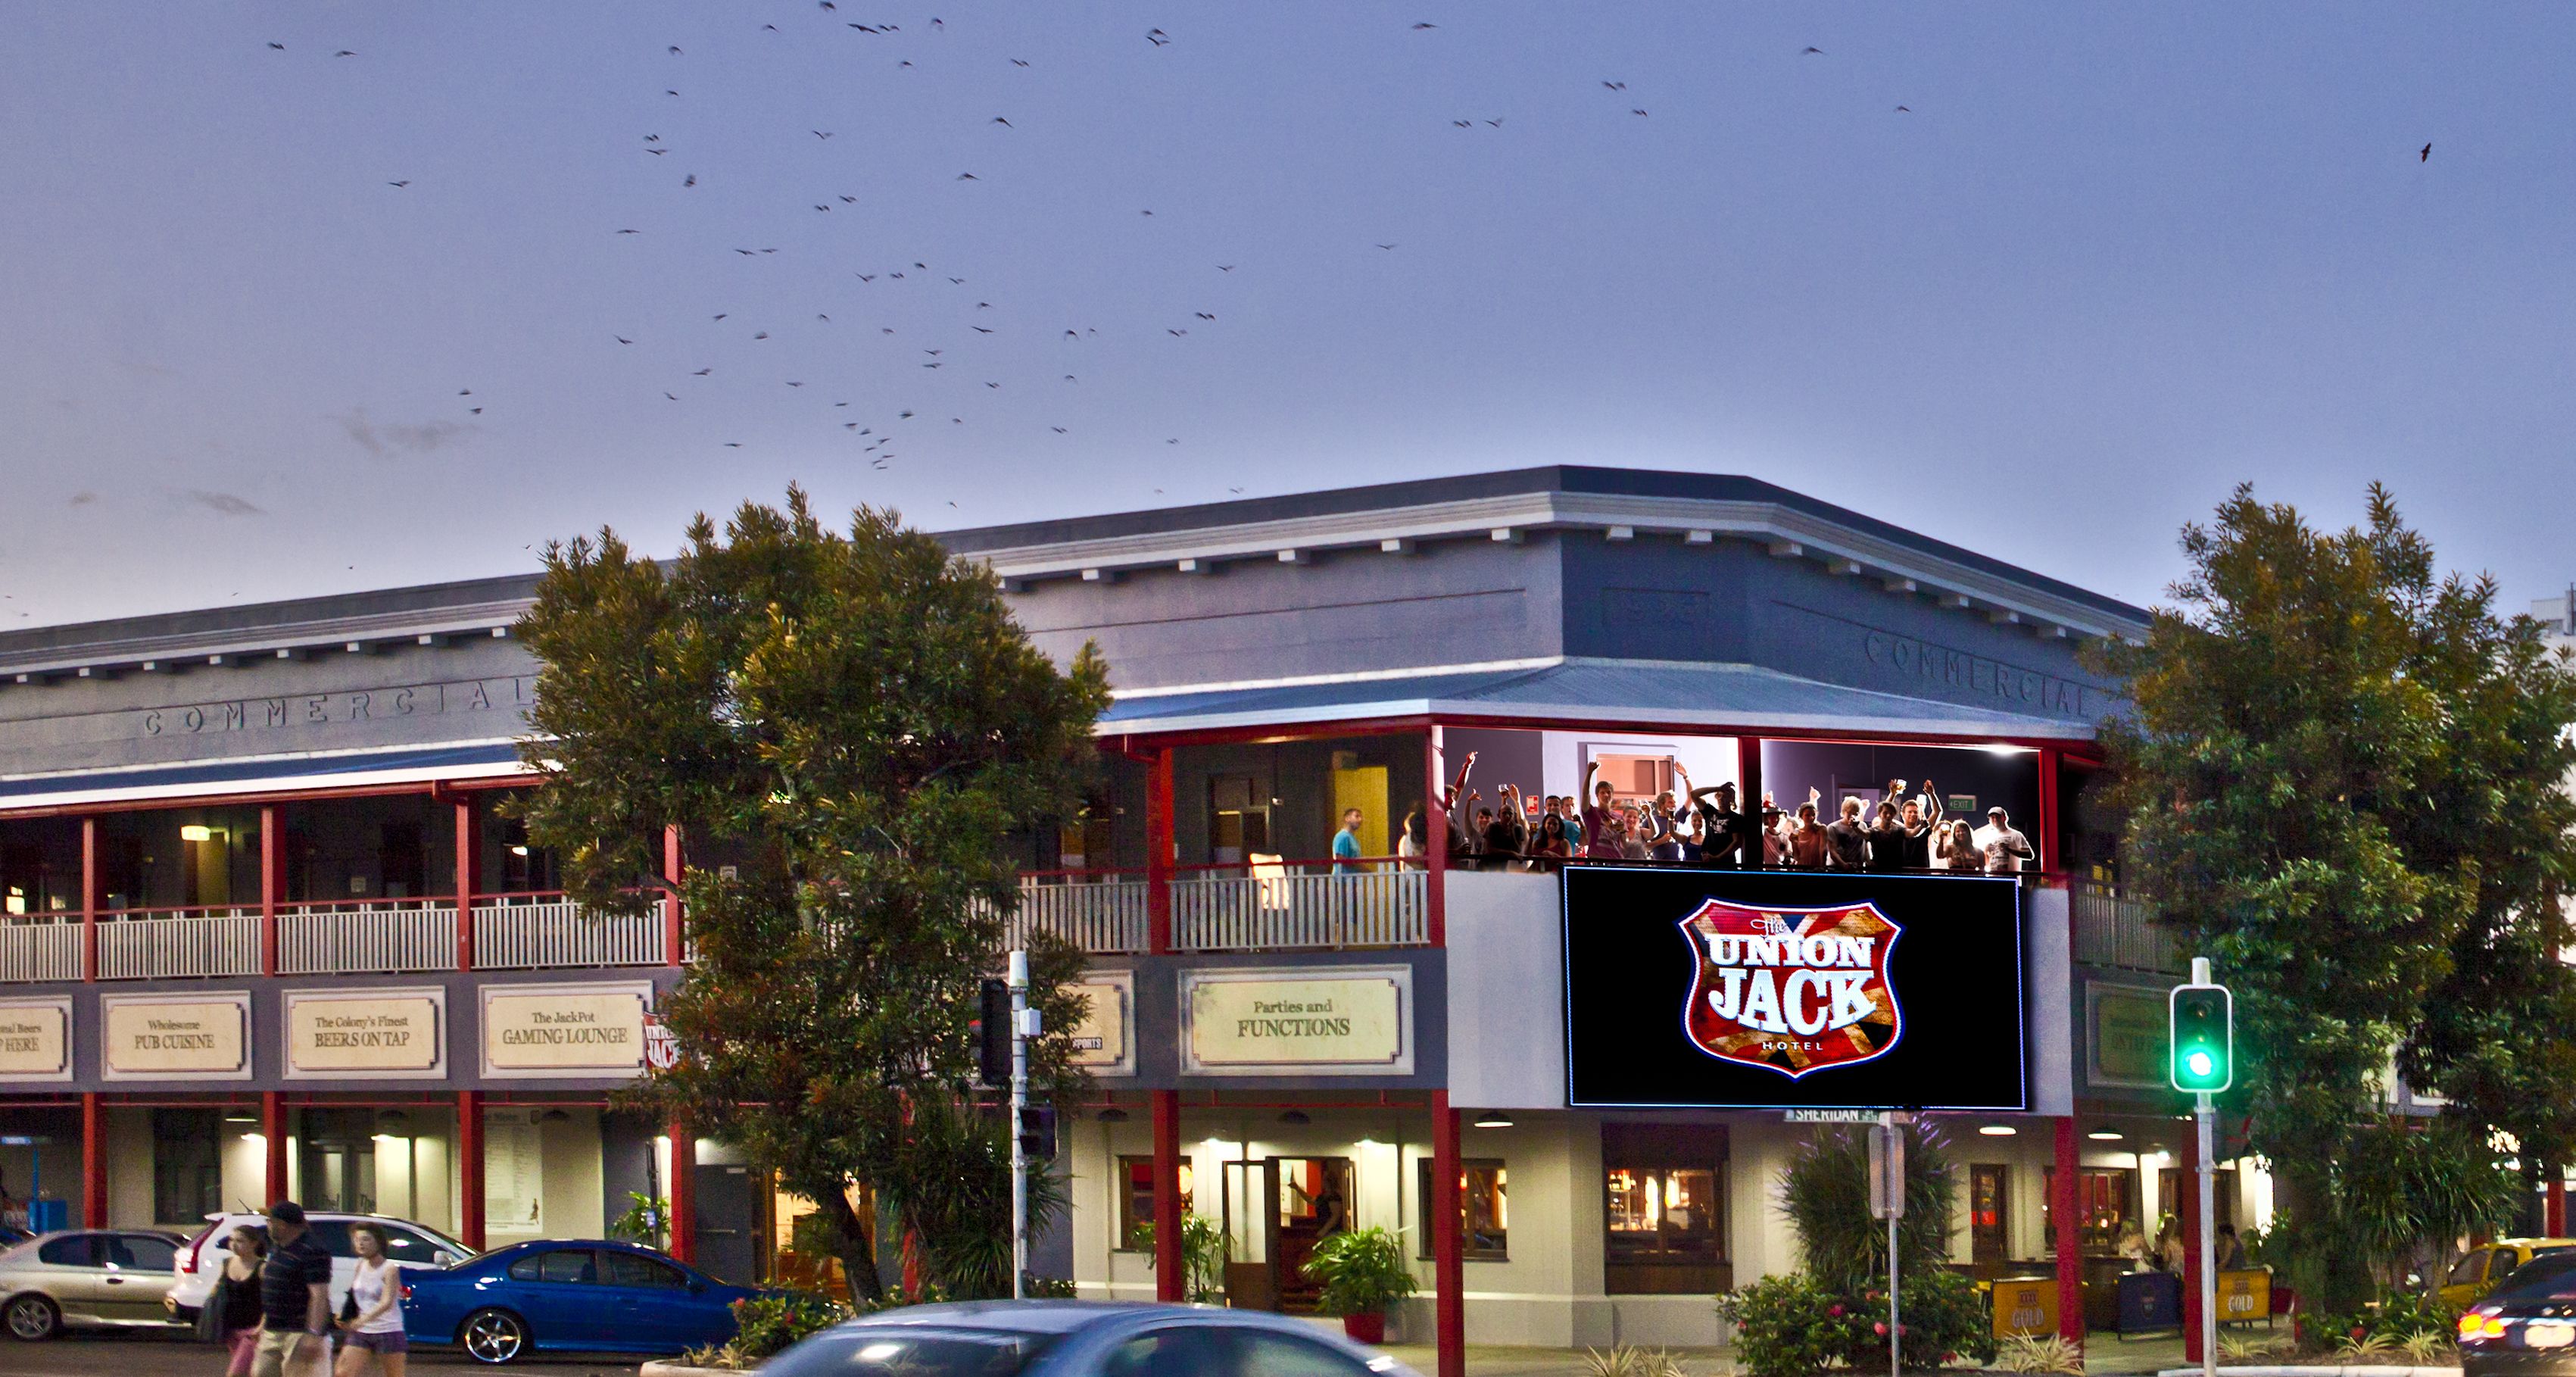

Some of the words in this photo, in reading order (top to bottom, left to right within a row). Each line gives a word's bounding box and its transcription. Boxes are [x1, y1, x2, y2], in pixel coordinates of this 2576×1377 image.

[1864, 635, 2089, 717] COMMERCIAL
[145, 679, 536, 736] COMMERCIAL
[1954, 800, 1969, 809] EXIT
[1750, 917, 1785, 938] The
[1704, 933, 1876, 967] UNION
[1254, 1000, 1303, 1013] Parties
[1306, 998, 1333, 1013] and
[1707, 967, 1877, 1036] JACK
[148, 1019, 200, 1030] Wholesome
[315, 1016, 334, 1028] The
[378, 1016, 408, 1026] Finest
[532, 1011, 552, 1023] The
[554, 1011, 595, 1023] JackPot
[1237, 1018, 1350, 1037] FUNCTIONS
[135, 1035, 160, 1049] PUB
[162, 1034, 214, 1049] CUISINE
[315, 1032, 358, 1047] BEERS
[361, 1032, 379, 1046] ON
[382, 1031, 410, 1046] TAP
[503, 1029, 563, 1044] GAMING
[566, 1028, 628, 1044] LOUNGE
[5, 1037, 39, 1052] HERE
[1762, 1041, 1823, 1051] HOTEL
[1795, 1110, 1858, 1121] SHERIDAN
[2228, 1295, 2253, 1311] GOLD
[2012, 1308, 2044, 1329] GOLD
